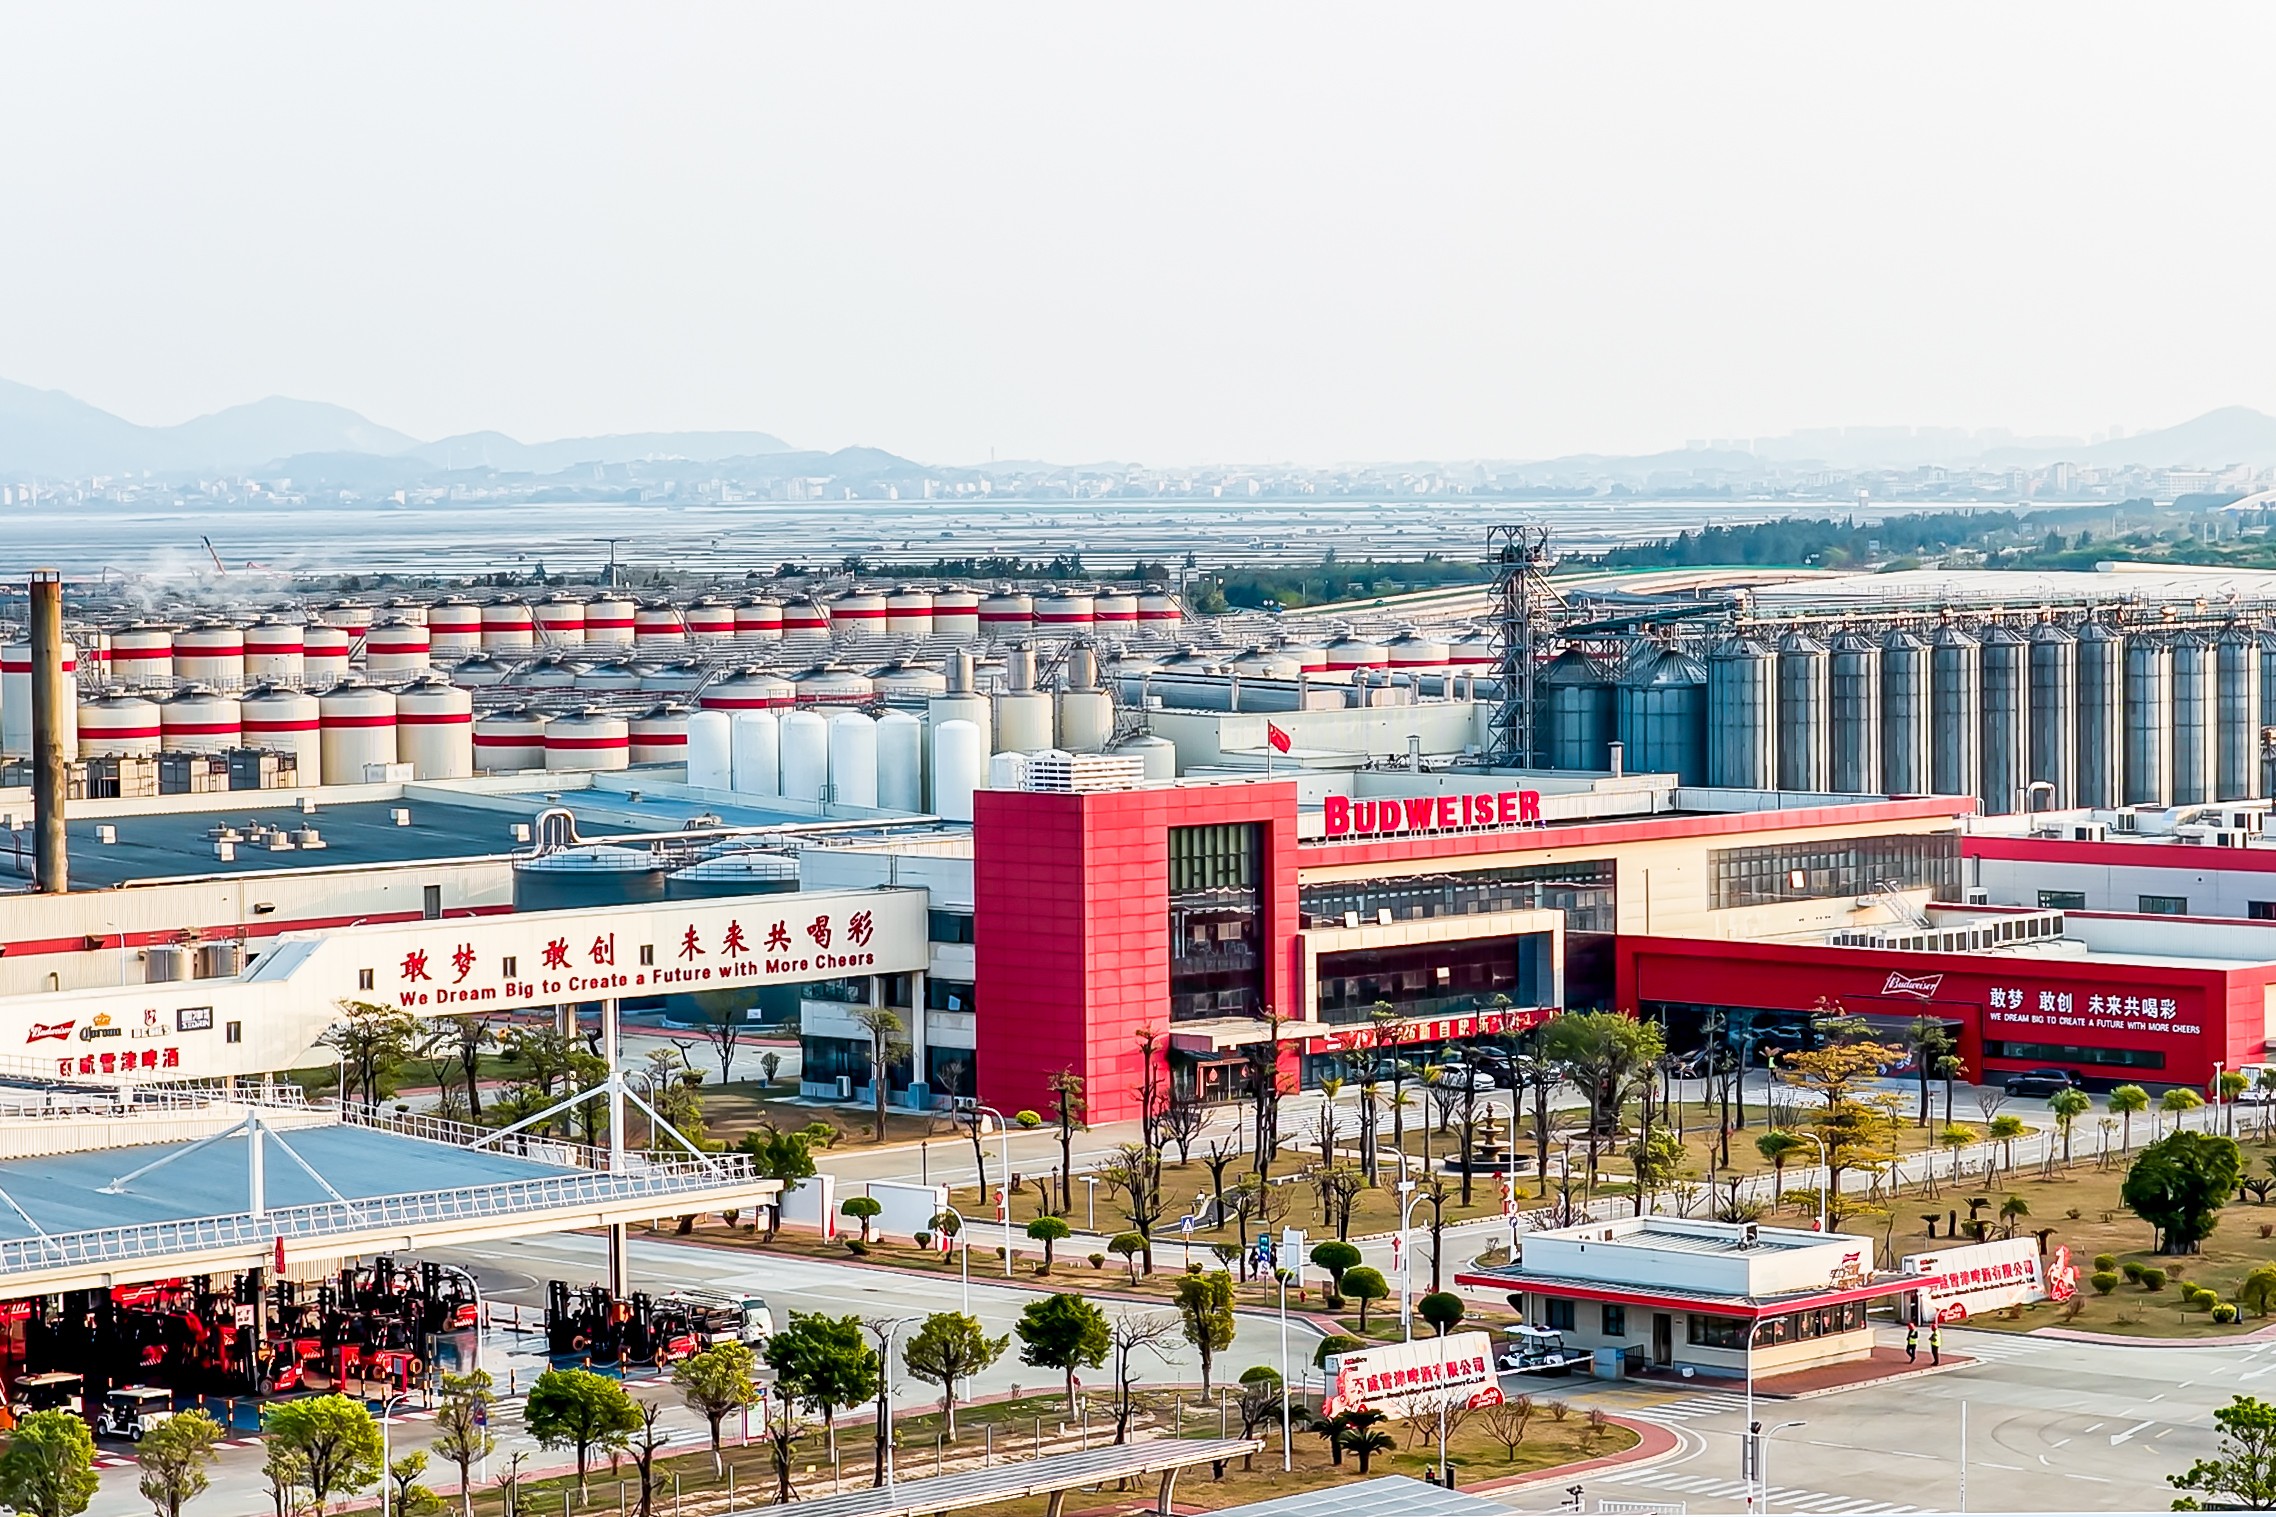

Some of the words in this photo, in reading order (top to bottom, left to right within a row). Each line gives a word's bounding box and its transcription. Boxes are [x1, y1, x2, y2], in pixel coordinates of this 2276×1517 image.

[1324, 790, 1540, 837] BUDWEISER
[400, 943, 477, 984] 敢梦
[542, 932, 615, 971] 敢创
[678, 910, 874, 962] 未来共喝彩
[400, 991, 428, 1007] We
[437, 987, 496, 1004] Dream
[506, 982, 534, 998] Big
[543, 979, 561, 994] to
[569, 973, 627, 991] Create
[636, 973, 645, 985] a
[653, 965, 711, 984] Future
[719, 961, 758, 978] with
[765, 958, 808, 975] More
[816, 952, 874, 969] Cheers
[1886, 976, 1937, 991] Budweiser
[1990, 987, 2023, 1010] 敢梦
[2039, 991, 2073, 1013] 敢创
[2088, 994, 2177, 1020] 未来共喝彩
[79, 1025, 122, 1042] Corona
[1990, 1012, 2001, 1021] WE
[2004, 1013, 2029, 1023] DREAM
[2031, 1014, 2044, 1024] BIG
[2047, 1015, 2057, 1025] TO
[2059, 1016, 2085, 1026] CREATE
[2089, 1018, 2095, 1027] A
[2097, 1018, 2124, 1029] FUTURE
[2127, 1021, 2146, 1031] WITH
[2148, 1022, 2169, 1032] MORE
[2172, 1023, 2200, 1034] CHEERS
